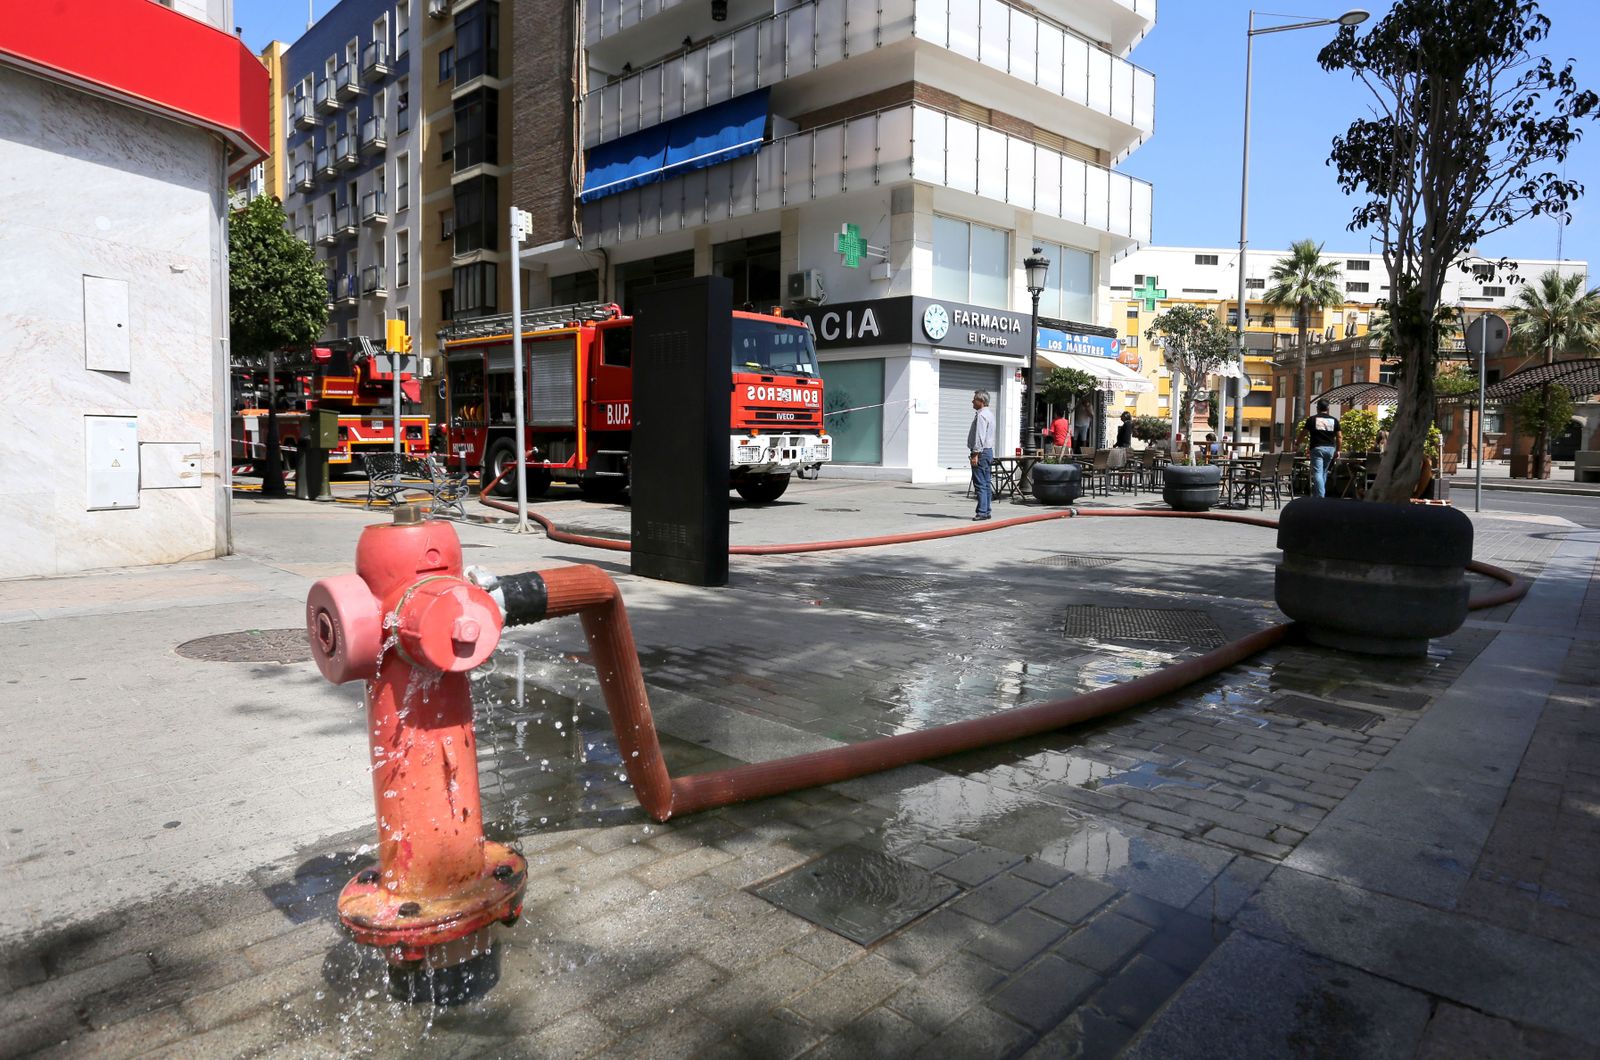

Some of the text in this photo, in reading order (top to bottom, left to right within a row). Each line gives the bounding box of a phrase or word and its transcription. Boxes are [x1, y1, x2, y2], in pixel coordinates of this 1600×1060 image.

[953, 309, 1021, 333] FARMACIA
[968, 332, 1008, 347] El Puerto
[1065, 333, 1089, 344] BAR
[1048, 339, 1105, 356] LOS MAESTRES
[776, 412, 795, 421] IVECO
